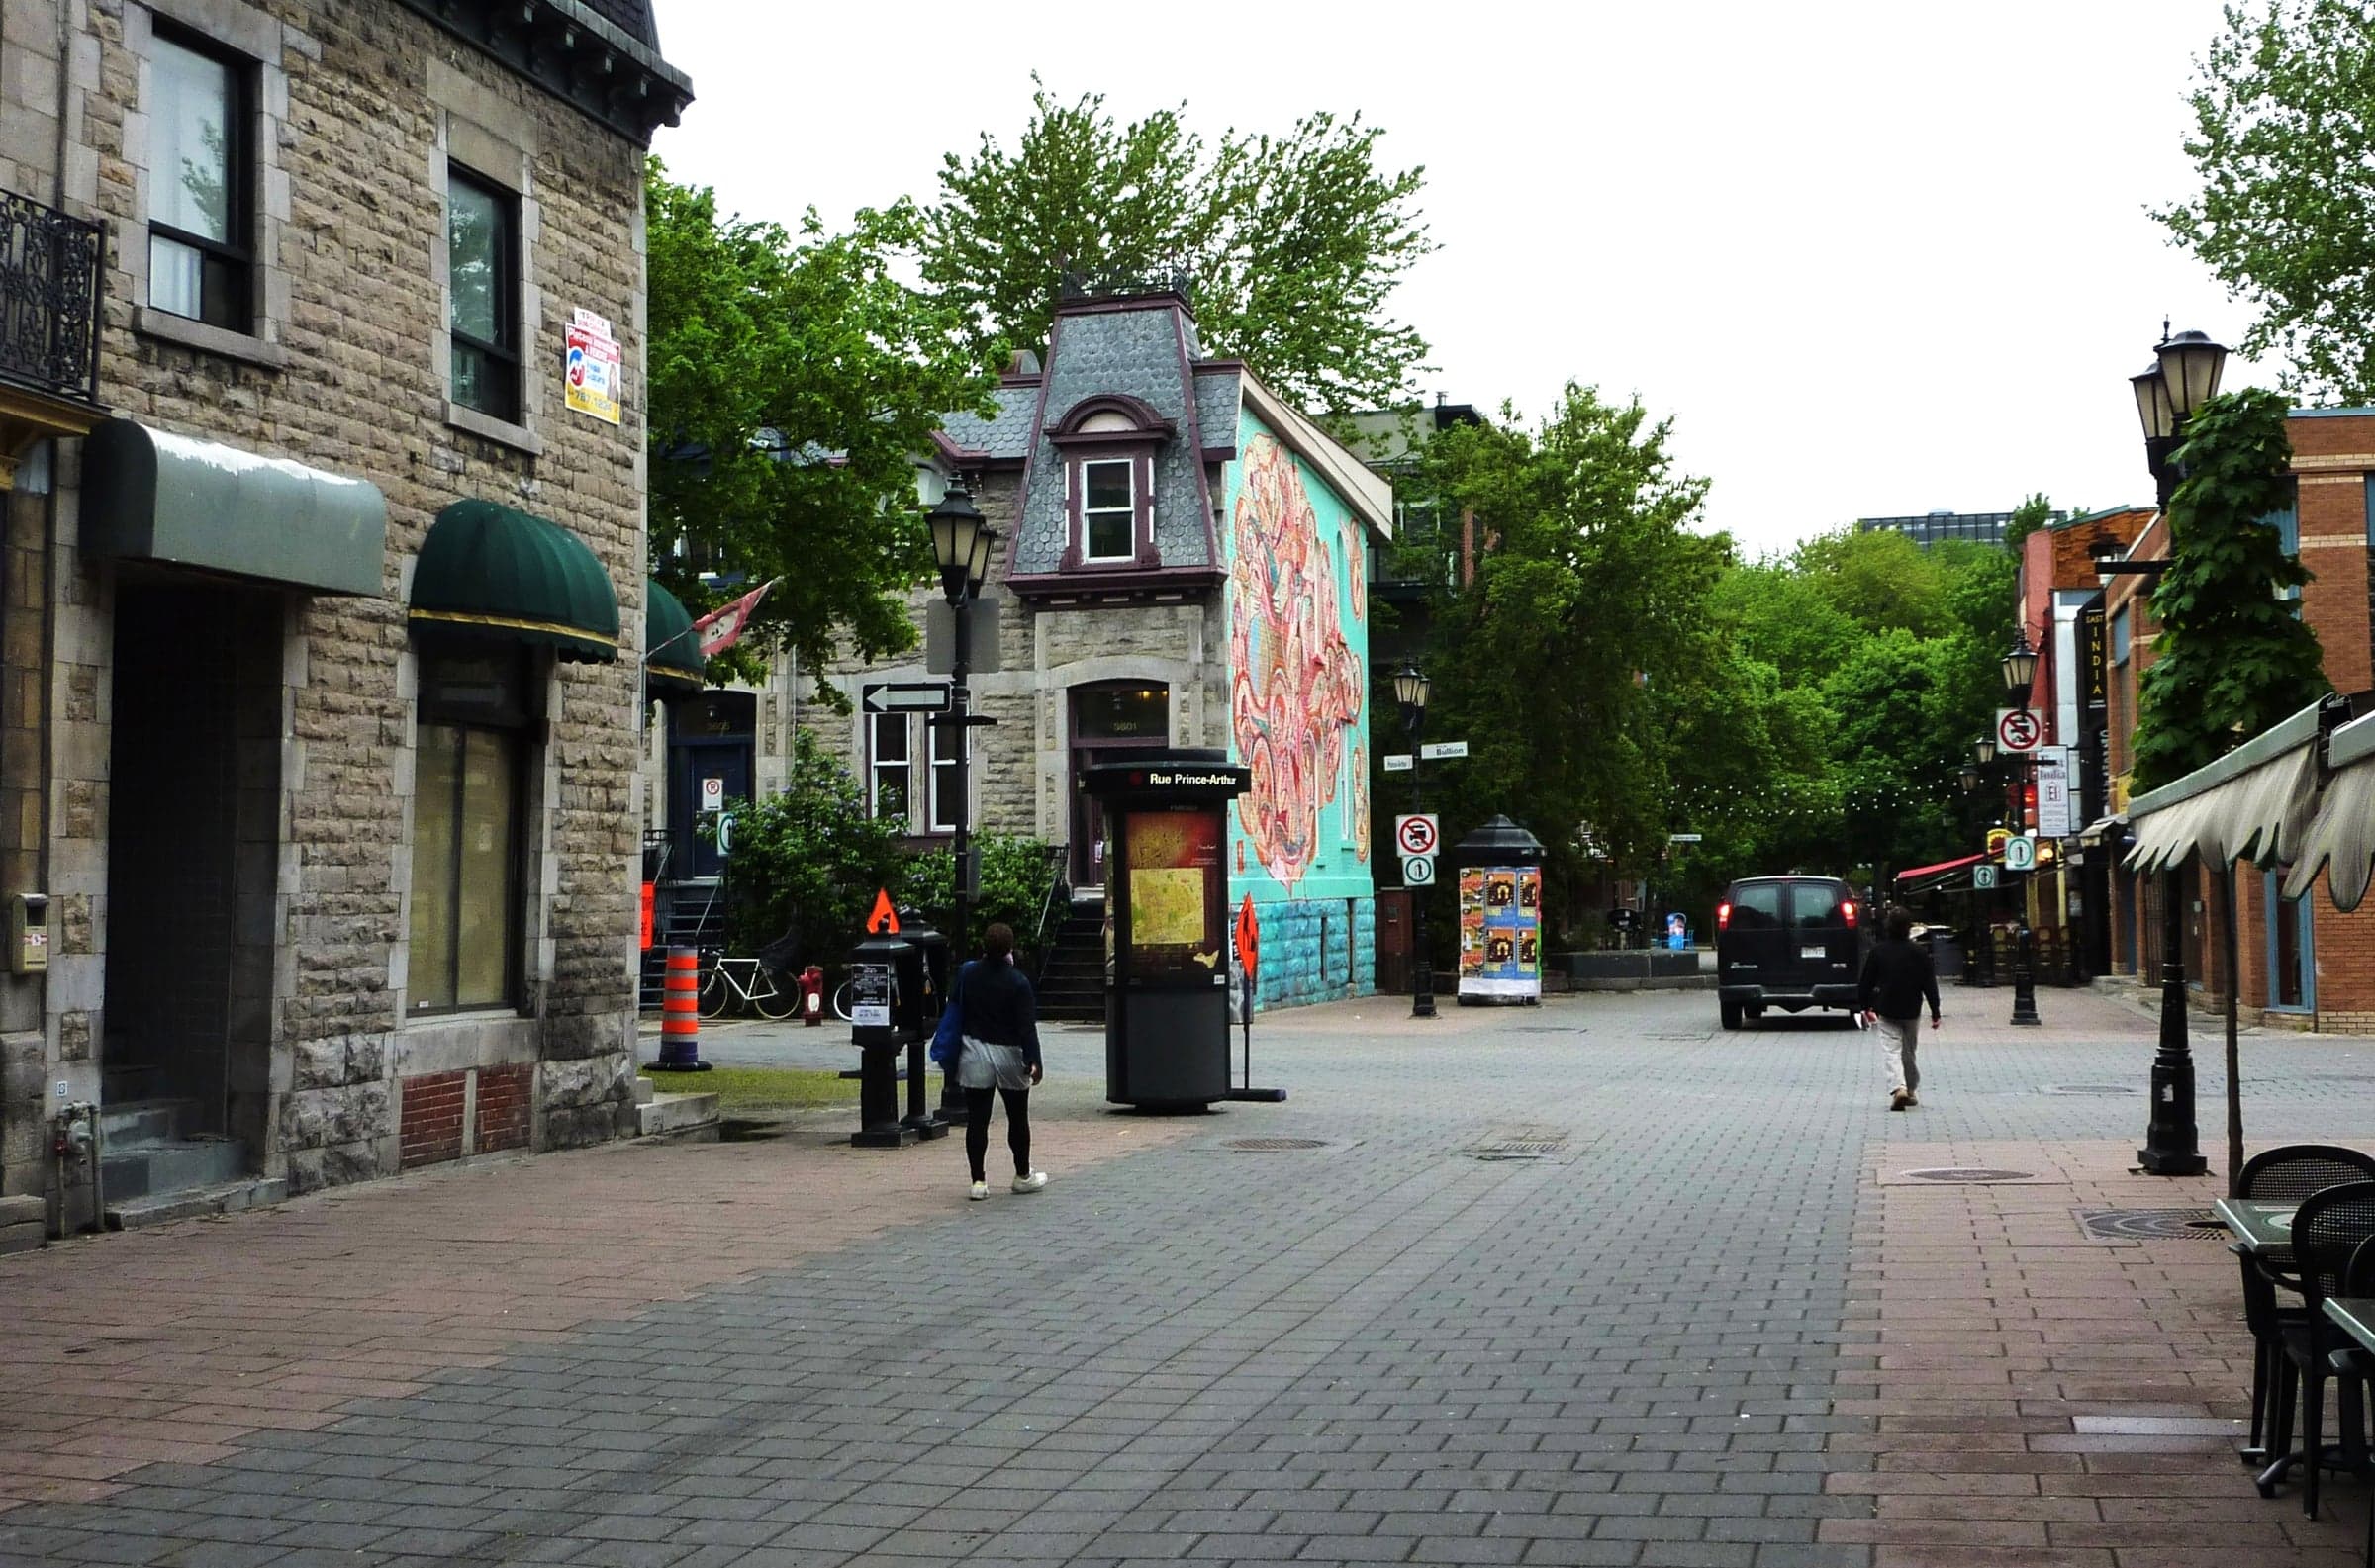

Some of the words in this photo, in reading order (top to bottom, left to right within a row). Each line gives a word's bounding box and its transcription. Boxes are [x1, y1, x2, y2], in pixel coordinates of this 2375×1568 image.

[2086, 615, 2103, 624] EAST
[2091, 627, 2103, 695] INDIA
[1436, 747, 1464, 756] Bullion
[1150, 773, 1172, 784] Rue
[1175, 773, 1237, 785] Prince-Arthur
[2040, 769, 2066, 781] India
